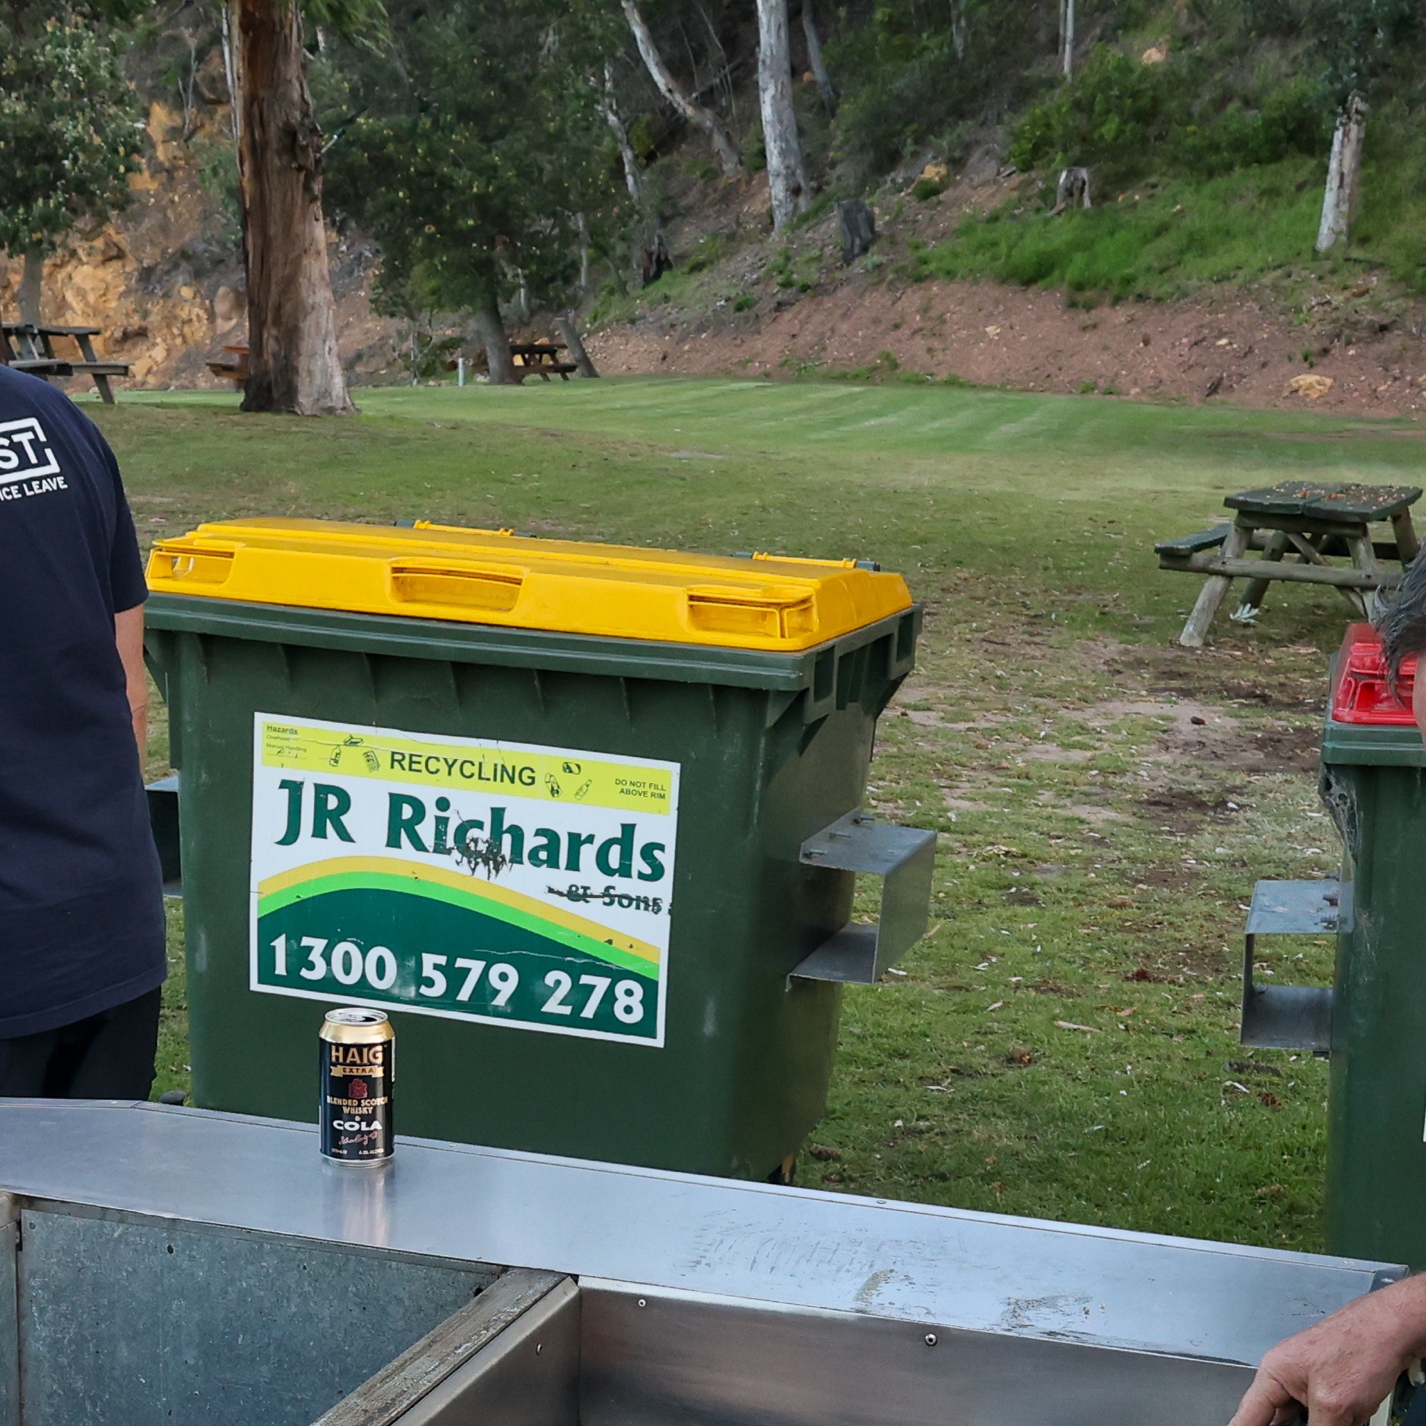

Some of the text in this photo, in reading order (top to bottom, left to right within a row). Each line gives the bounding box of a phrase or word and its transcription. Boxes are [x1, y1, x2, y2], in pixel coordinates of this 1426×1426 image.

[23, 475, 68, 496] LEAVE
[267, 725, 298, 736] Hazards
[390, 751, 537, 786] RECYCLING
[615, 778, 667, 792] DO NOT FILL
[619, 788, 666, 800] ABOVE RIM
[275, 778, 666, 882] JR Richards
[601, 884, 664, 914] Sons
[270, 932, 645, 1024] 1300 579 278
[331, 1044, 384, 1064] HAIG
[327, 1095, 388, 1106] BLENDED SCOTCH
[342, 1106, 373, 1115] WHISKY
[333, 1120, 382, 1131] COLA
